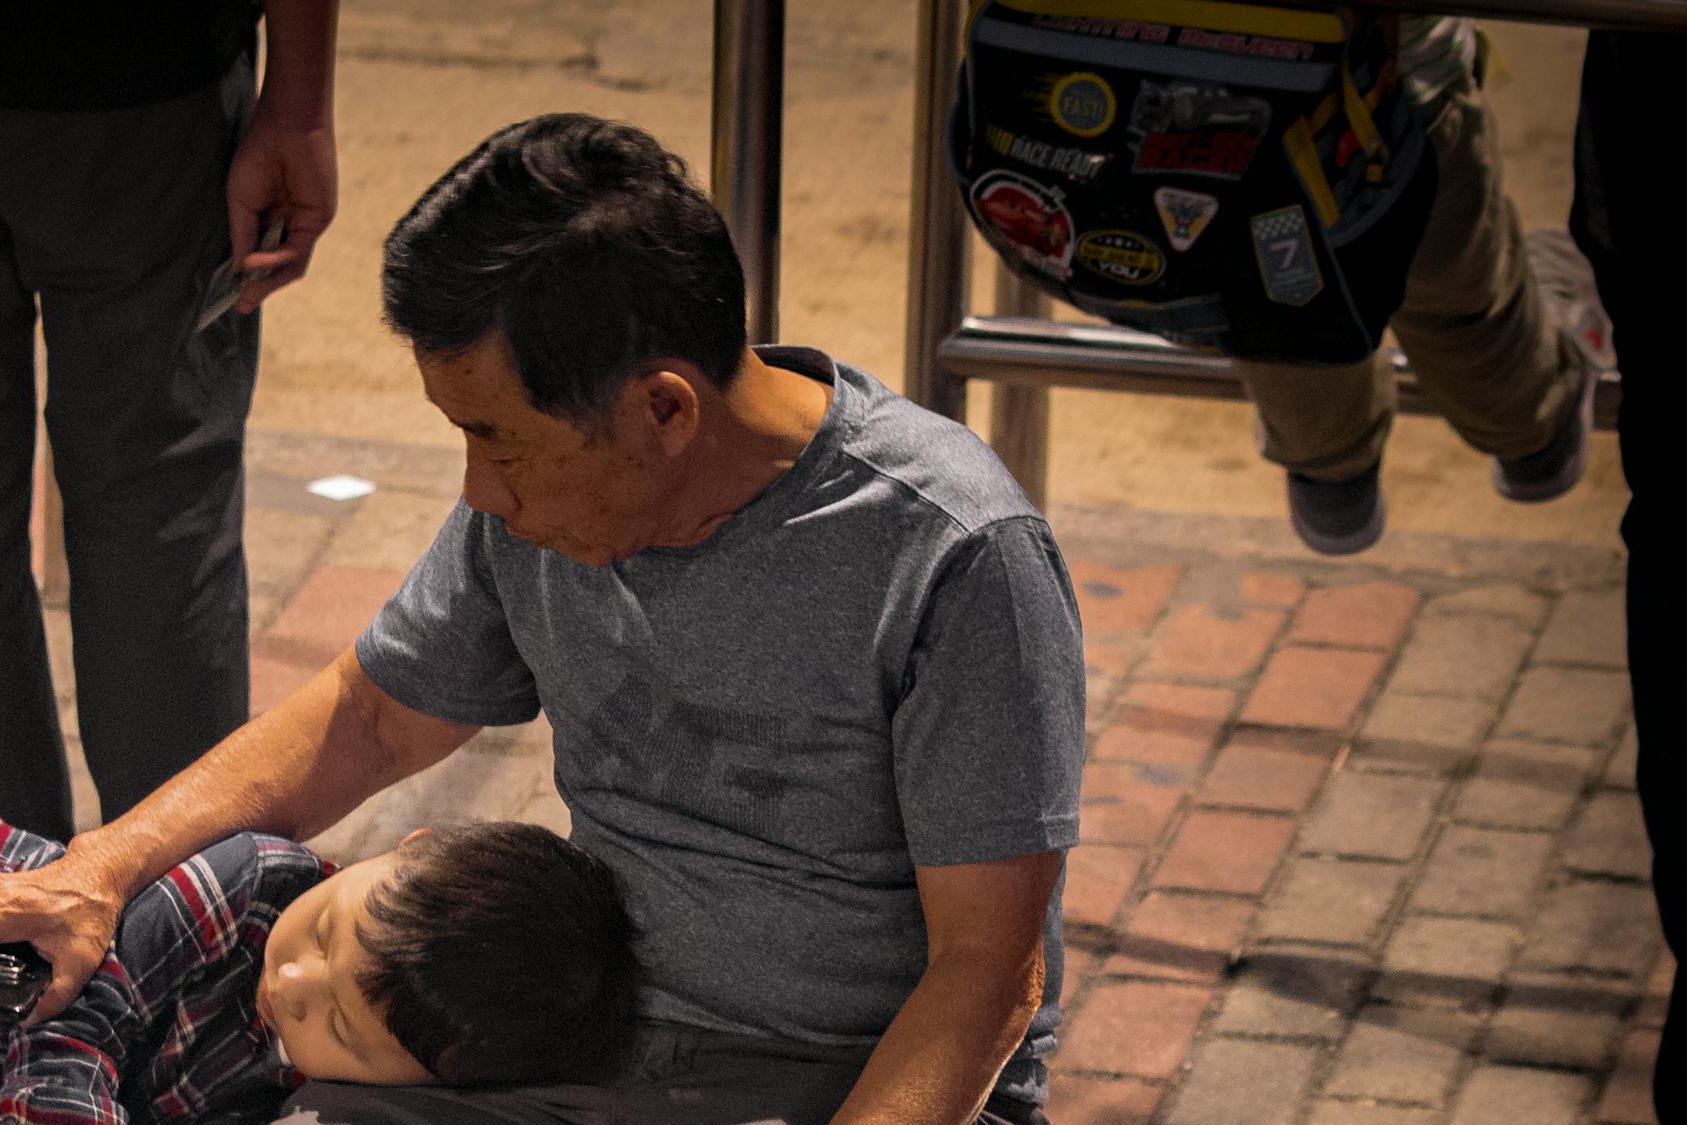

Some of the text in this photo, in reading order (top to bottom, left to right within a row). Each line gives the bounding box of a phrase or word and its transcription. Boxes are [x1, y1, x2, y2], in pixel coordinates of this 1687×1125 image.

[1011, 138, 1052, 168] RACE
[1270, 239, 1298, 269] 7
[1098, 261, 1140, 280] YOU
